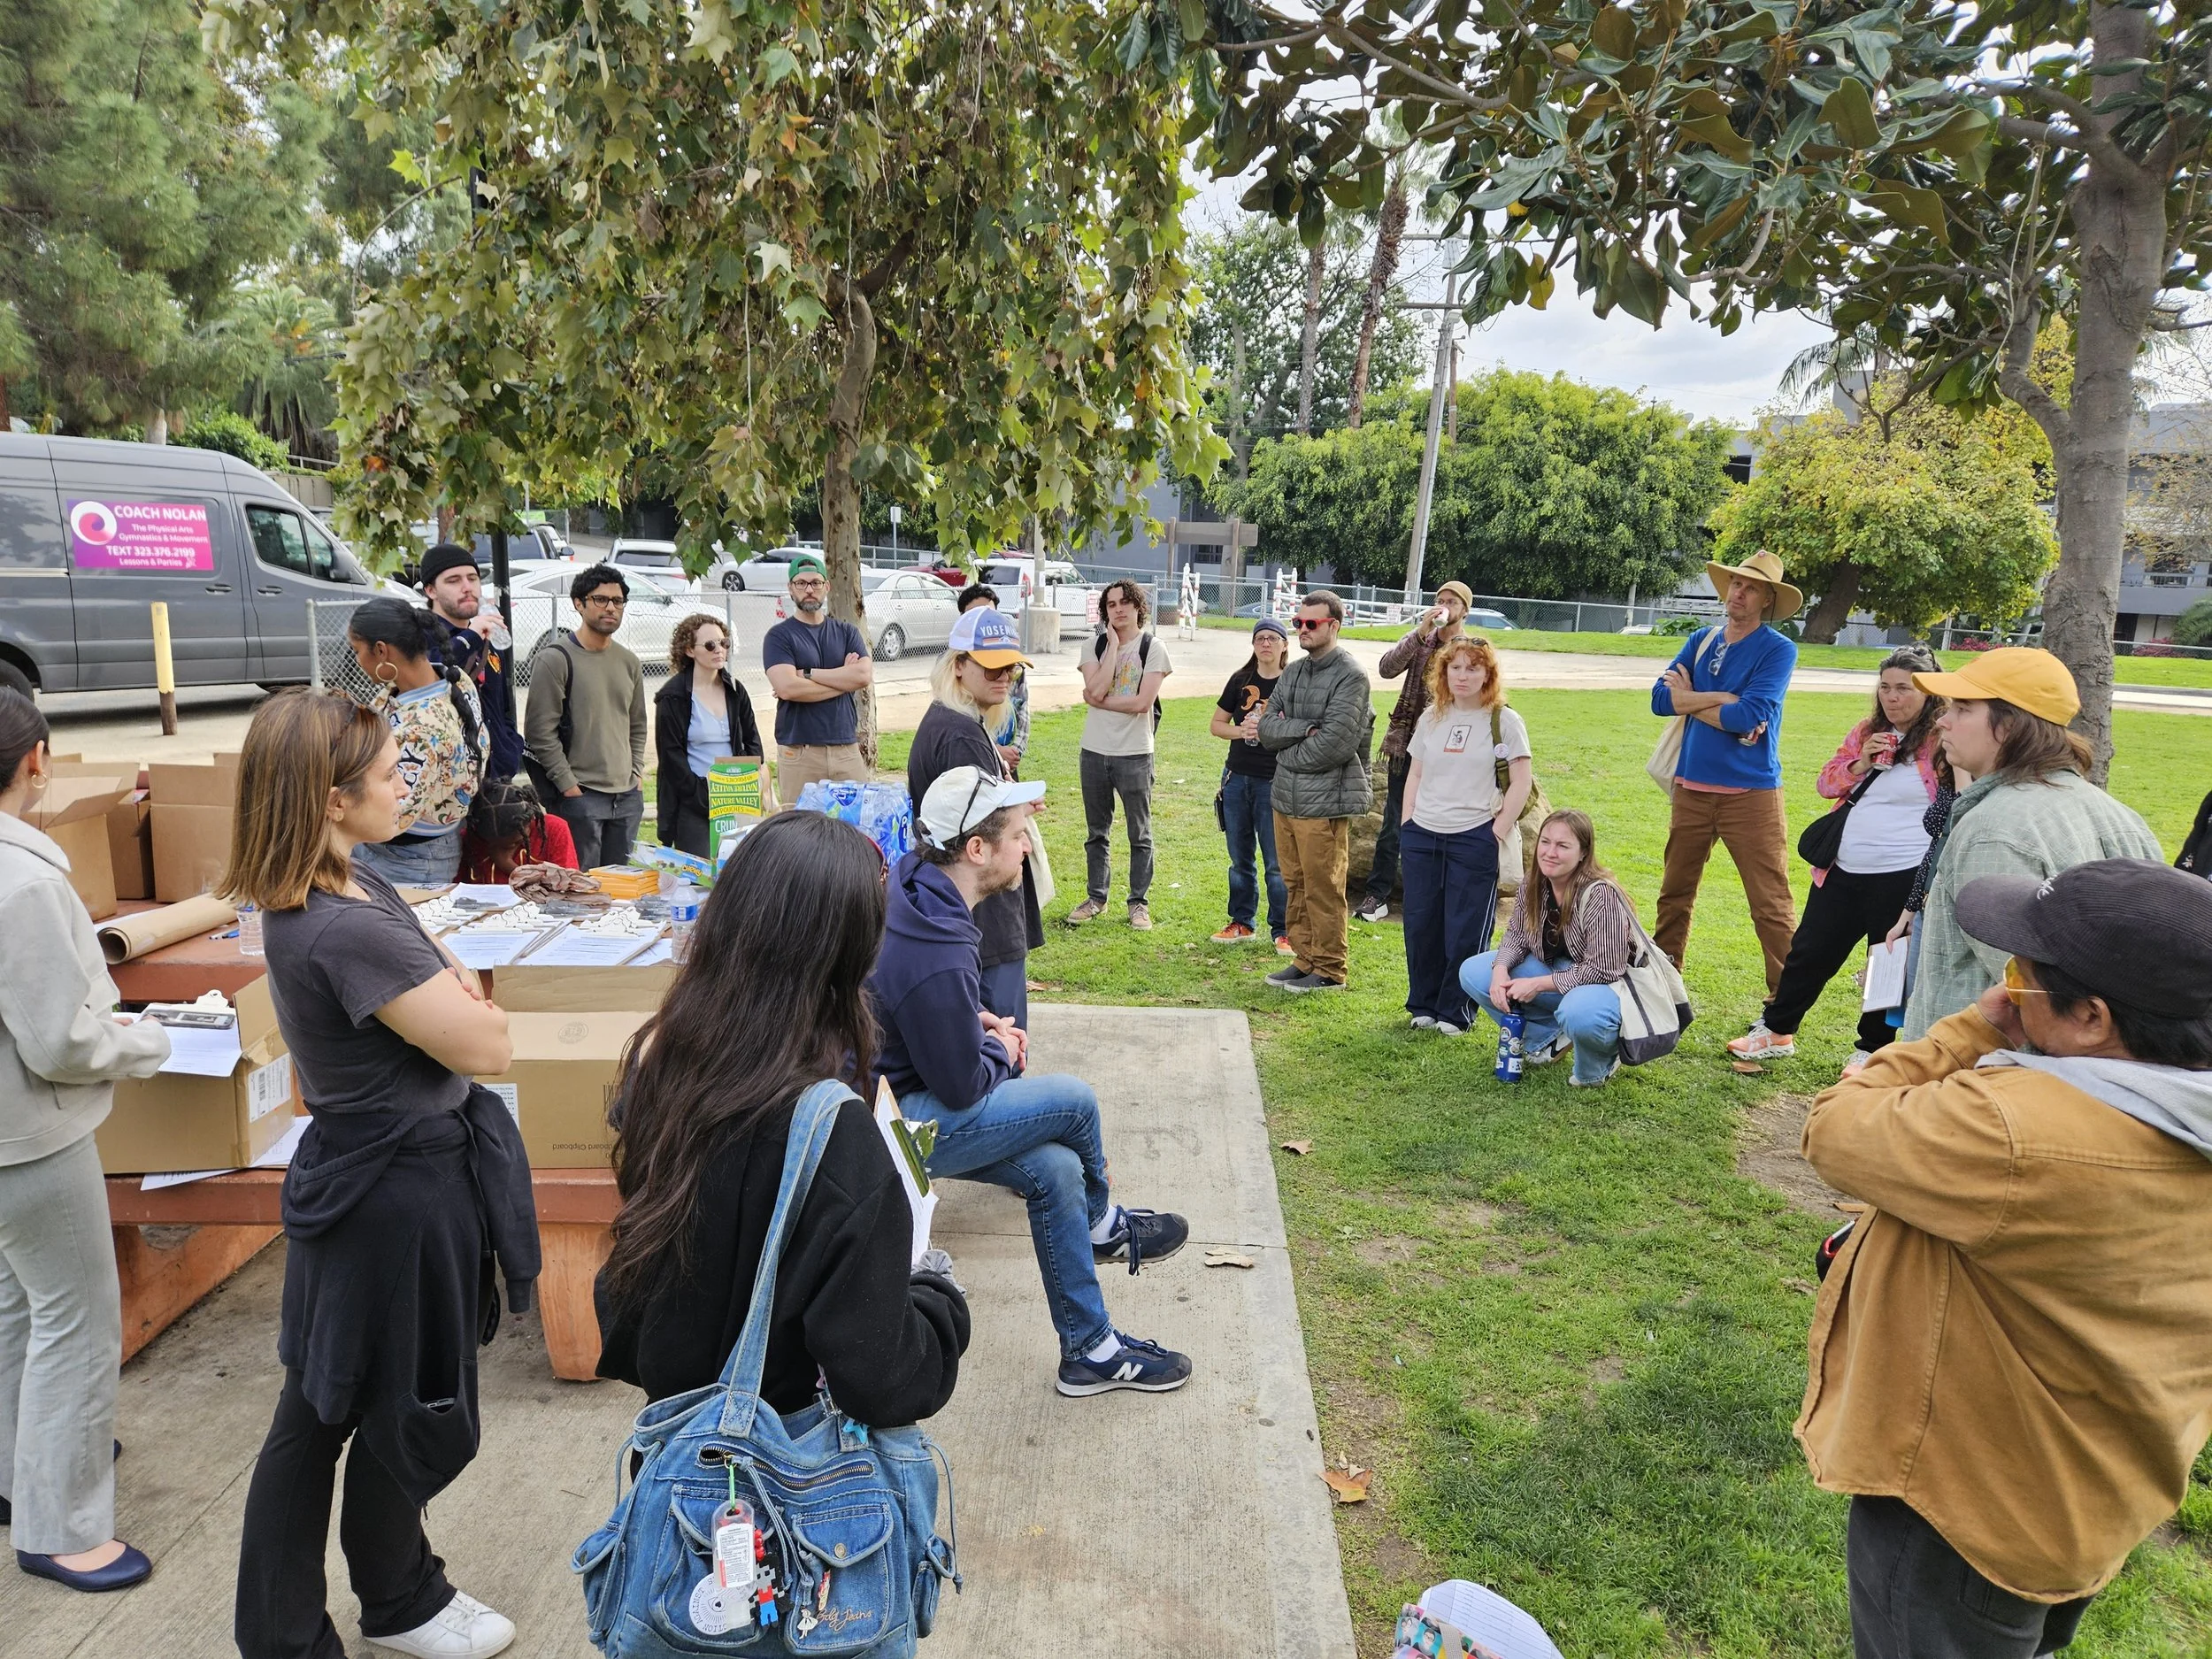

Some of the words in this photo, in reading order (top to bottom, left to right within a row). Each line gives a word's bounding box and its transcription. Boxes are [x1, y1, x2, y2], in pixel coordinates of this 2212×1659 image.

[114, 505, 160, 519] COACH
[162, 508, 206, 521] NOLAN
[147, 524, 178, 534] Physical
[119, 533, 162, 542] Gymnastics
[169, 534, 208, 543] Movement
[106, 545, 132, 556] TEXT
[119, 557, 150, 566] Lessons
[710, 782, 733, 792] VALLEY
[733, 782, 758, 792] NATURE
[710, 797, 735, 808] NATURE
[736, 797, 758, 807] VALLEY
[552, 1142, 587, 1151] Clipboard
